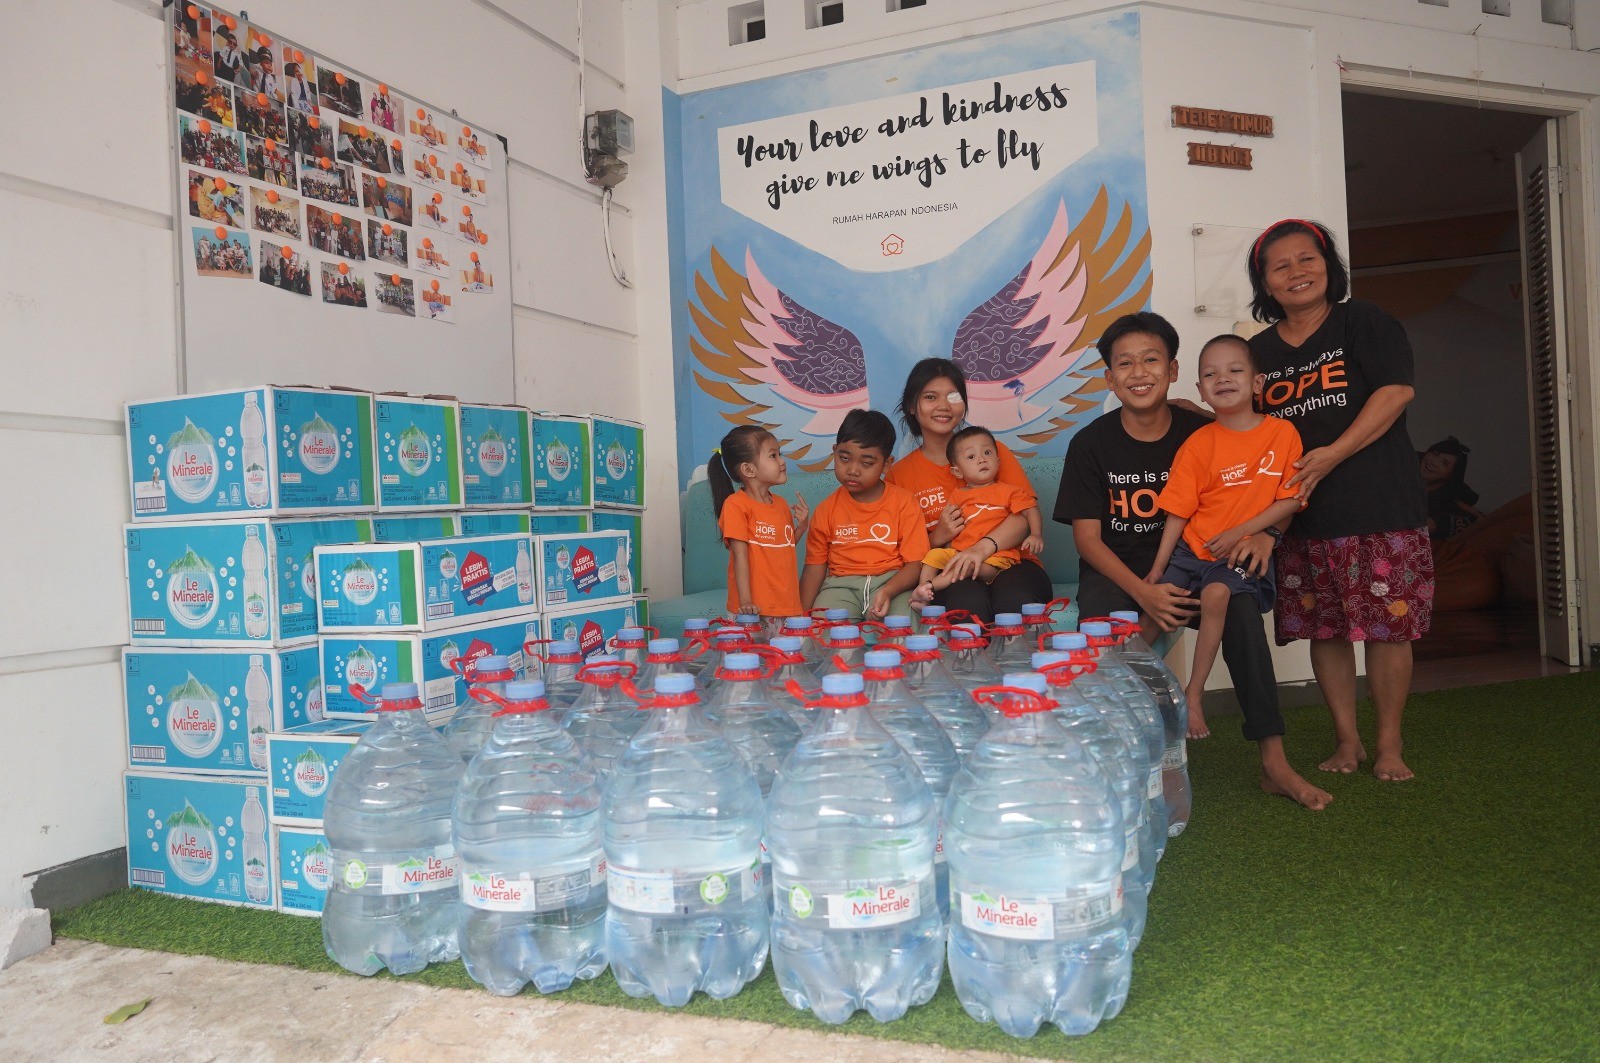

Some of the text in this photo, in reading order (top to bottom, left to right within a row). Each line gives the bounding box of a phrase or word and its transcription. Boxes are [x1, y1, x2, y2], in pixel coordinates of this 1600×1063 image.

[737, 82, 1070, 168] Your love and kindness
[1181, 108, 1272, 134] TEBET TIMUR
[765, 128, 1044, 210] give me wings to fly
[832, 214, 863, 225] RUMAH
[865, 208, 907, 221] HARAPAN
[1285, 366, 1294, 378] is
[1298, 348, 1344, 371] always
[314, 436, 324, 446] Le
[184, 452, 196, 464] Le
[172, 462, 213, 478] Minerale
[1144, 470, 1156, 483] is
[920, 492, 946, 508] OPE
[756, 526, 776, 536] HOPE
[836, 528, 858, 536] HOPE
[1110, 518, 1130, 532] for
[465, 561, 483, 574] LEBIH
[574, 560, 596, 574] PRAKTIS
[576, 555, 590, 566] LEBIH
[462, 568, 488, 584] PRAKTIS
[186, 578, 198, 591] Le
[173, 590, 214, 602] Minerale
[584, 628, 598, 640] LEBIH
[582, 634, 602, 650] PRAKTIS
[357, 662, 364, 670] Le
[186, 706, 199, 720] Le
[172, 718, 216, 732] Minerale
[306, 766, 314, 774] Le
[184, 832, 196, 846] Le
[172, 843, 212, 860] Minerale
[428, 858, 441, 870] Le
[403, 866, 454, 882] Minerale
[491, 876, 505, 888] Le
[473, 884, 520, 900] Minerale
[879, 887, 894, 900] Le
[852, 897, 910, 915] Minerale
[1001, 897, 1018, 912] Le
[976, 906, 1037, 926] Minerale
